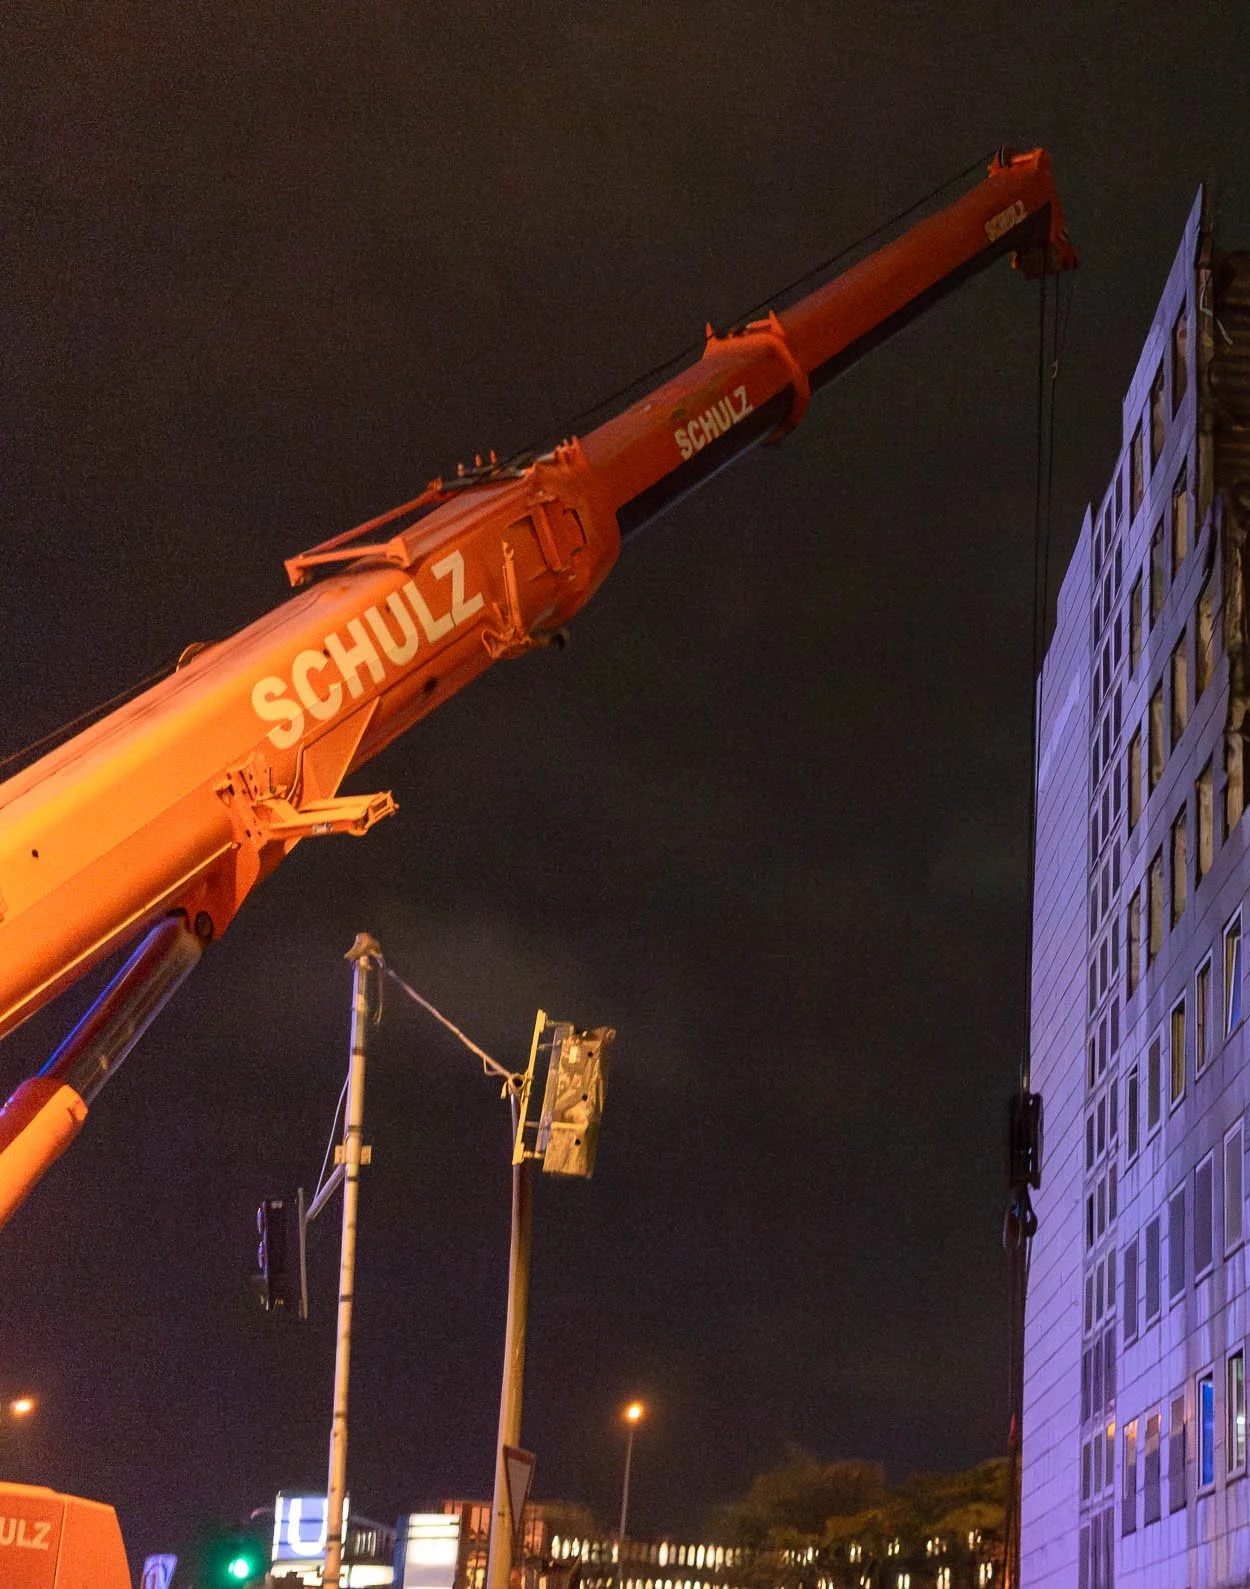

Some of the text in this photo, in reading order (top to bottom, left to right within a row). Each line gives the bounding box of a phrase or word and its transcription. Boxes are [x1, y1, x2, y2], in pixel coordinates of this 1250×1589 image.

[674, 385, 754, 461] SCHULZ
[251, 549, 485, 750] SCHULZ
[0, 1516, 51, 1551] ULZ
[288, 1498, 329, 1557] U
